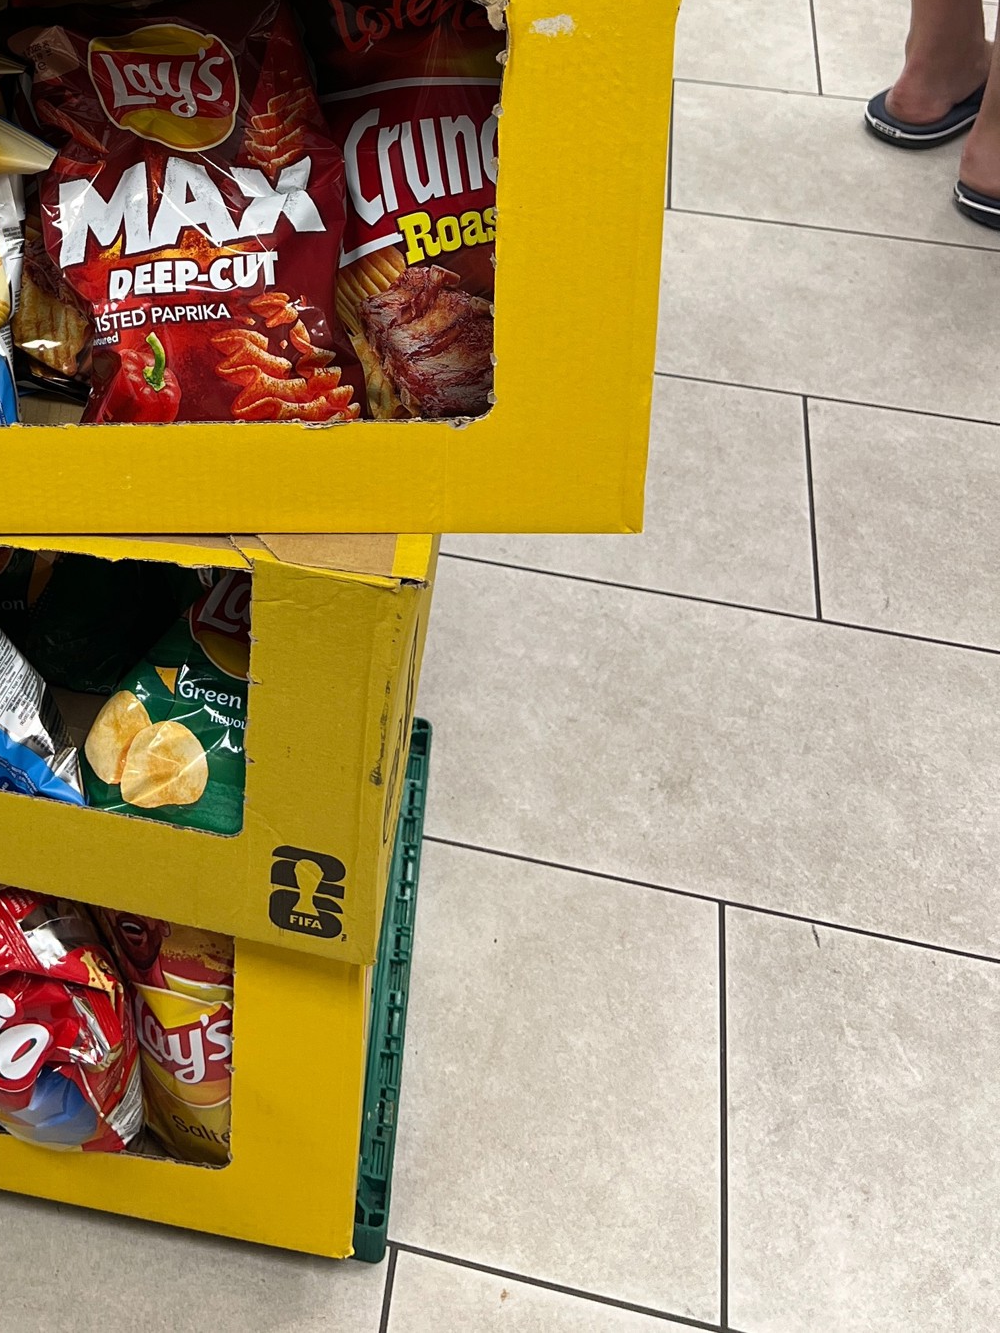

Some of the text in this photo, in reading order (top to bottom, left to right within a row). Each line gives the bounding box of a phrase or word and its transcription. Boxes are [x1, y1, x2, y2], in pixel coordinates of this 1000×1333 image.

[106, 49, 225, 117] Lay's
[58, 156, 327, 268] MAX
[108, 250, 280, 300] DEEP-CUT
[151, 303, 232, 324] PAPRIKA
[178, 680, 242, 709] Green
[289, 913, 323, 932] FIFA
[171, 1115, 230, 1144] Salte
